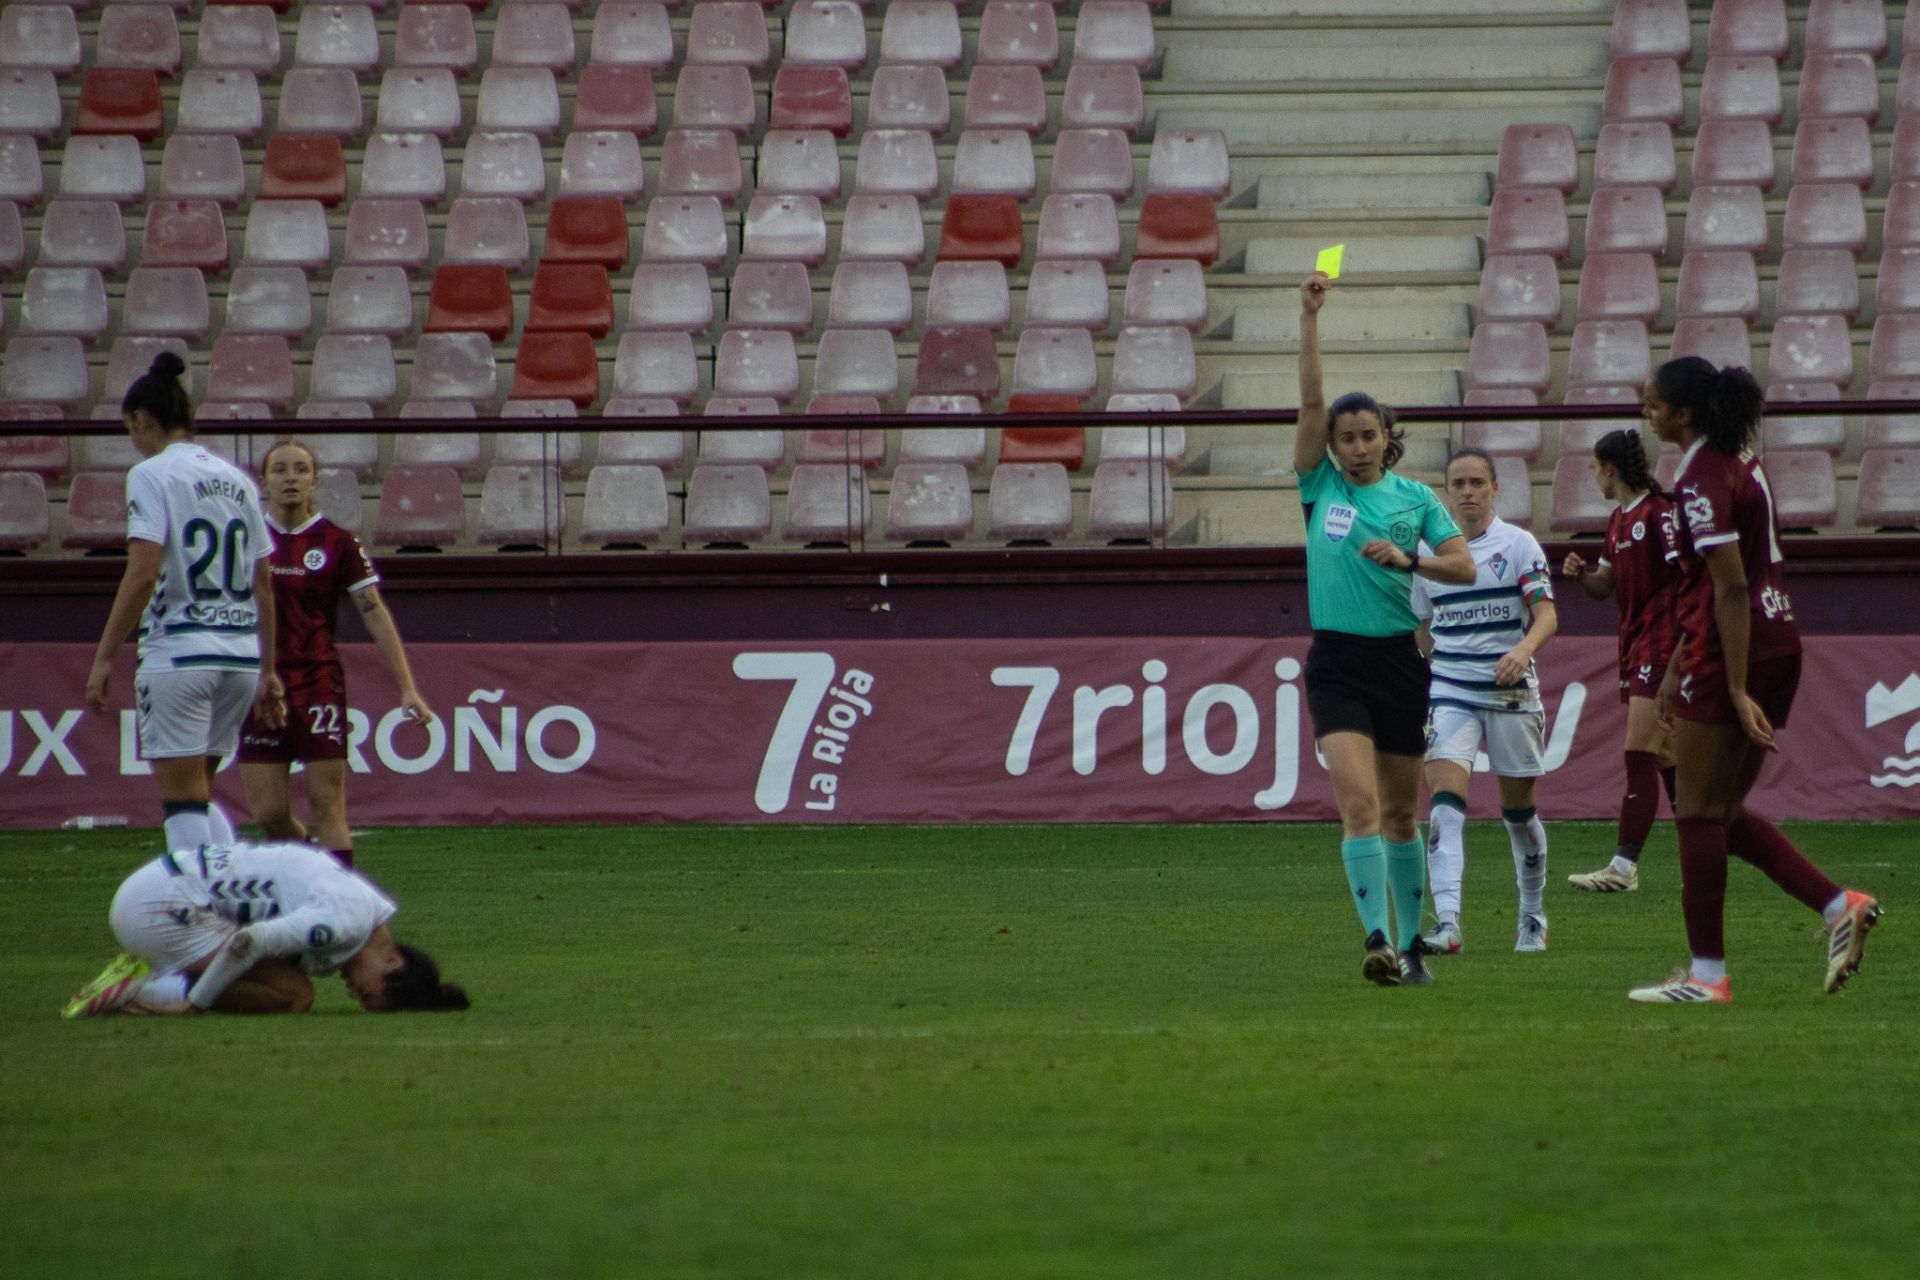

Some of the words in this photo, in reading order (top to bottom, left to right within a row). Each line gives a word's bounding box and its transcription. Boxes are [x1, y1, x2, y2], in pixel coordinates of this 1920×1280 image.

[193, 478, 246, 507] MIREIA
[1328, 506, 1352, 519] FIFA
[182, 518, 253, 603] 20
[308, 705, 340, 734] 22
[732, 652, 835, 813] 7
[805, 770, 835, 811] La
